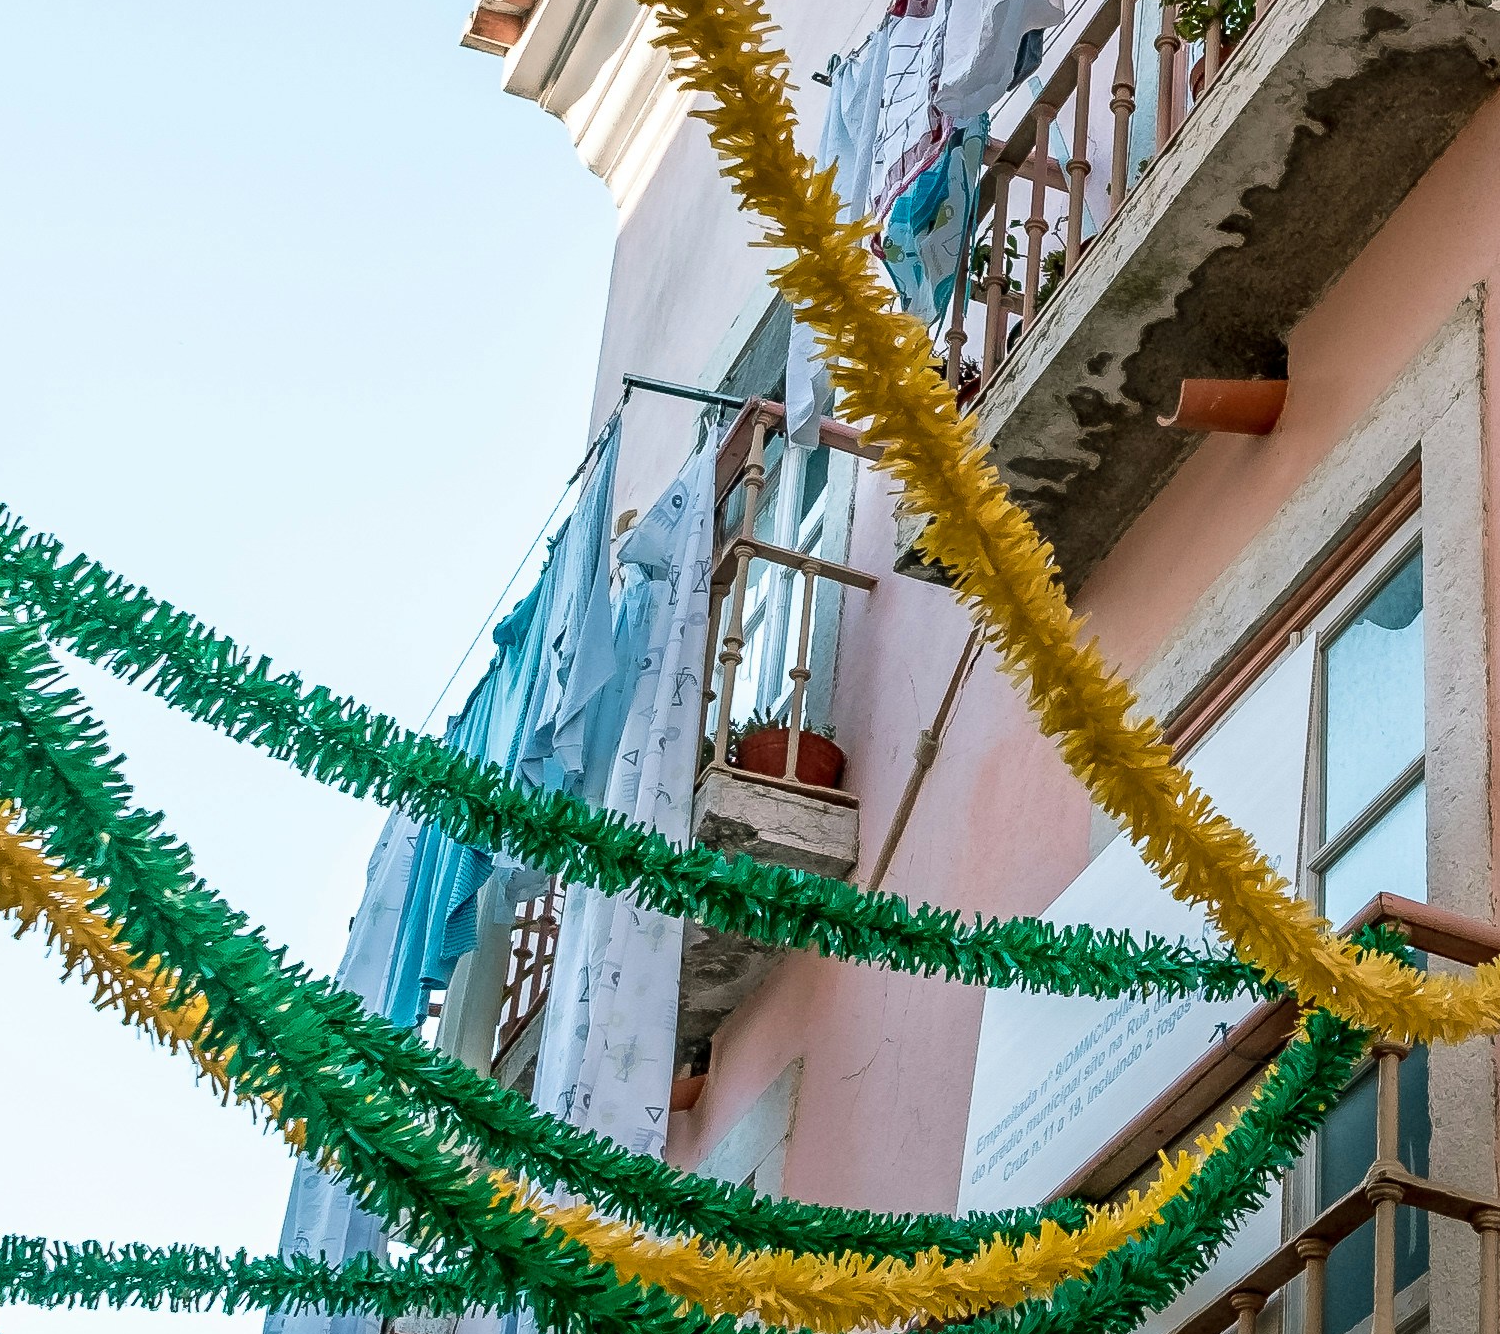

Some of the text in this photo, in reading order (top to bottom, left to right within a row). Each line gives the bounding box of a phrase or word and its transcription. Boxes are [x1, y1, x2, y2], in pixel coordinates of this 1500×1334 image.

[1003, 1148, 1029, 1182] Cruz
[1087, 1043, 1143, 1105] incluindo
[1145, 1027, 1153, 1051] 2
[1156, 1002, 1192, 1040] fogos
[1026, 1069, 1081, 1136] municipal
[1126, 1007, 1150, 1040] Rua
